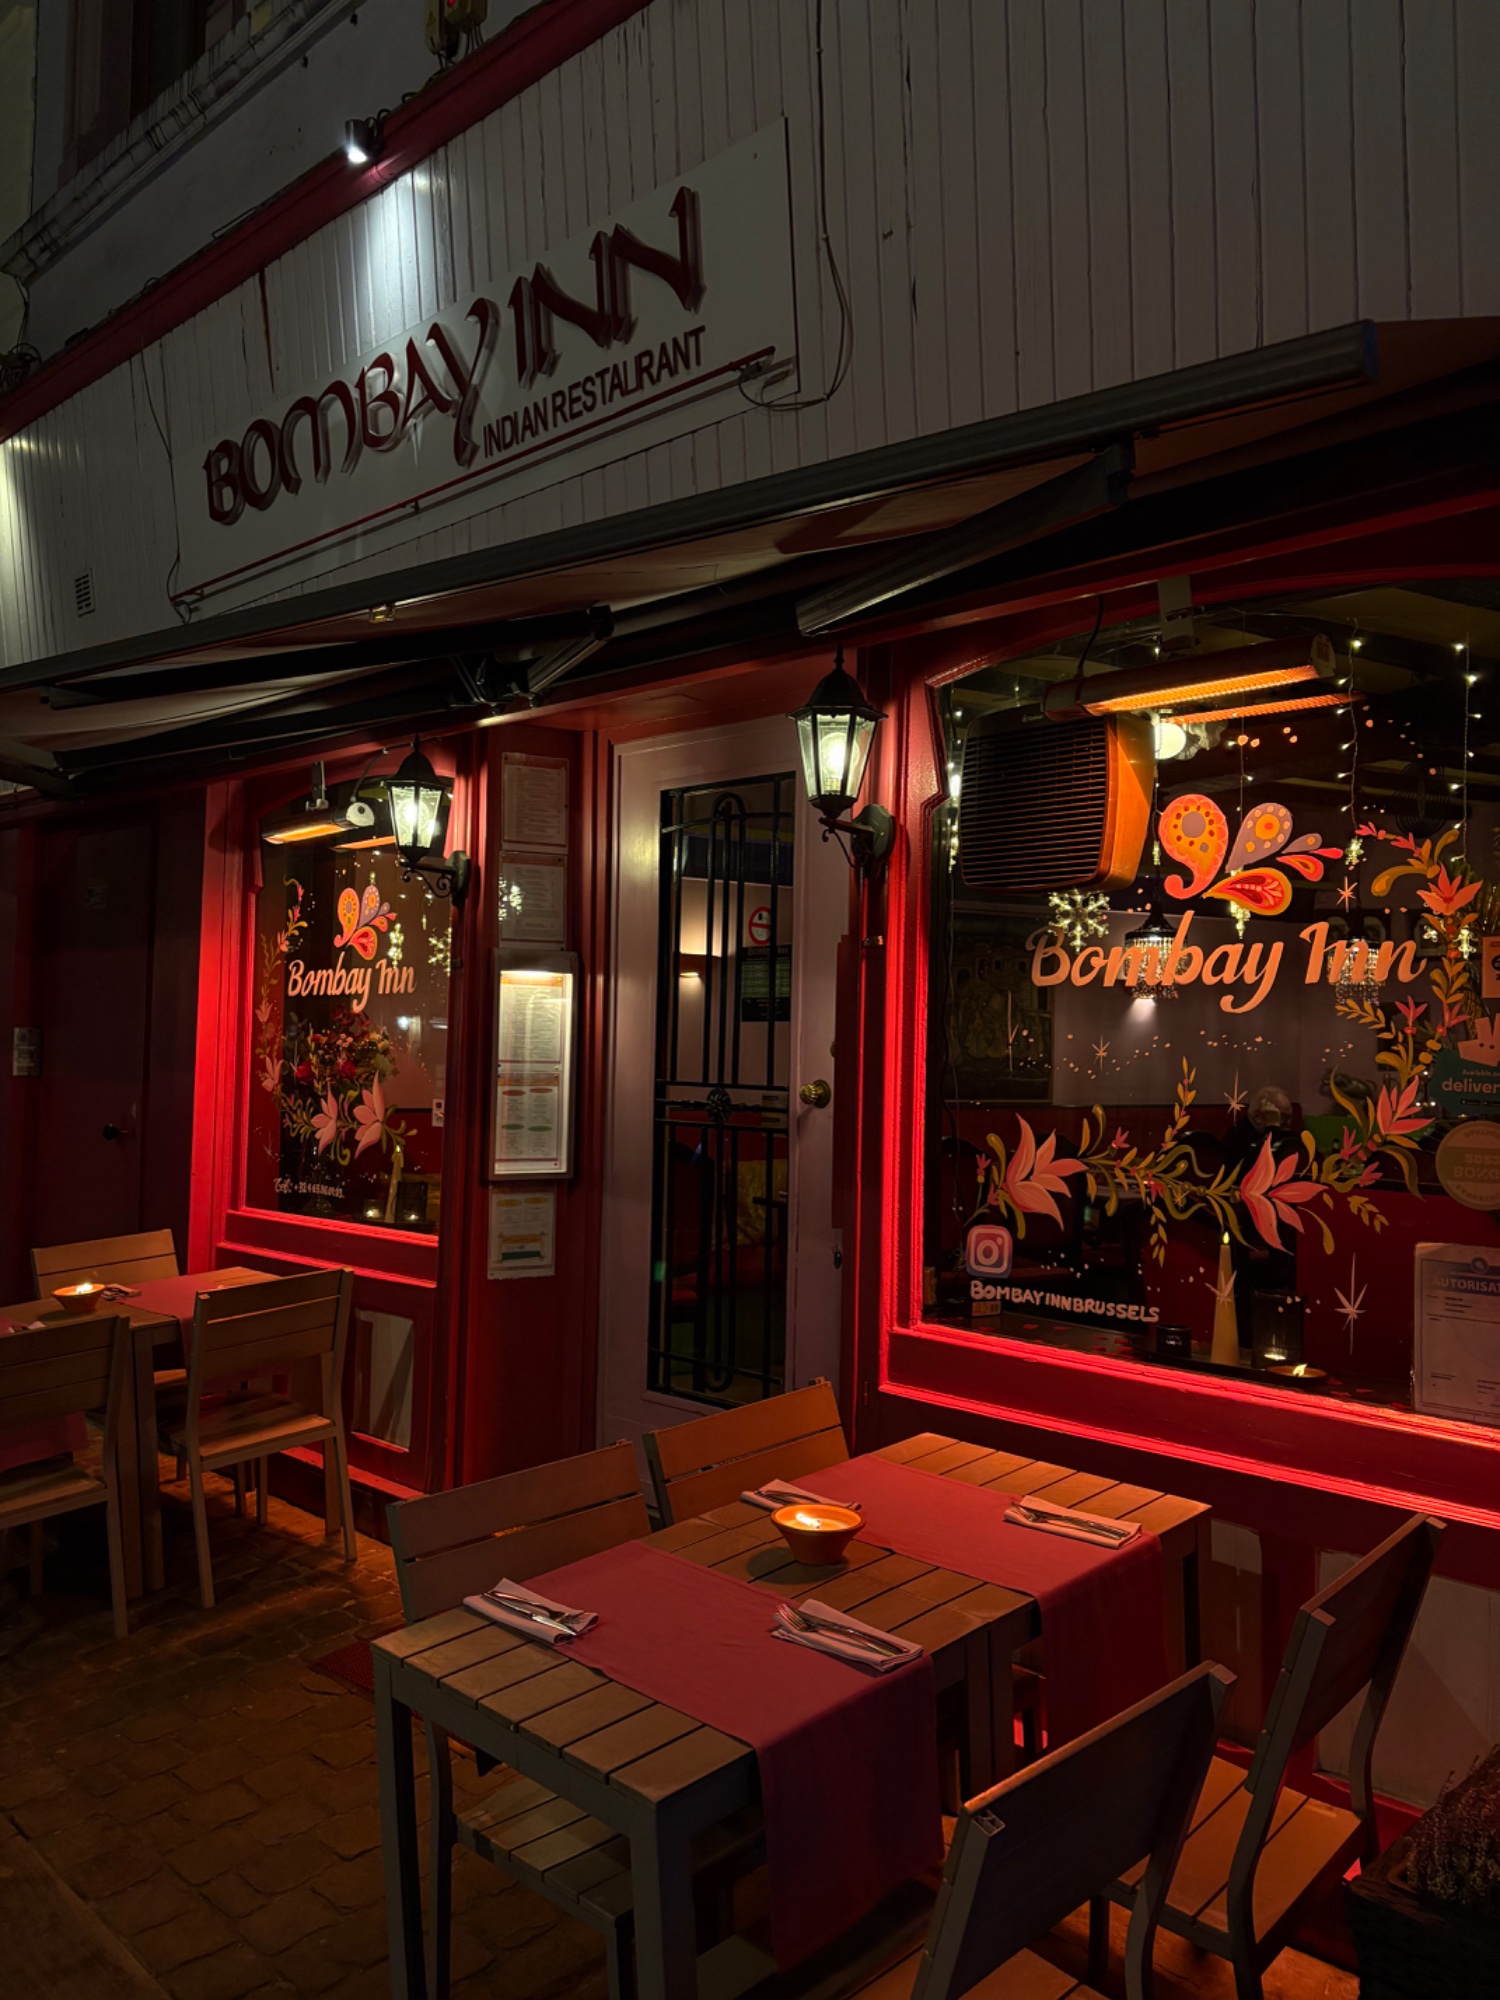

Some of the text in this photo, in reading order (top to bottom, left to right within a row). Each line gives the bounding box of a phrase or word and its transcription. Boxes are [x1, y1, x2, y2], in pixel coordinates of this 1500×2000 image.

[203, 186, 704, 525] BOMBAY INN
[483, 325, 706, 457] INDIAN RESTAURANT
[288, 951, 417, 1013] Bombay Inn
[1025, 909, 1428, 1014] Bombay Inn
[1442, 1077, 1500, 1094] deliver
